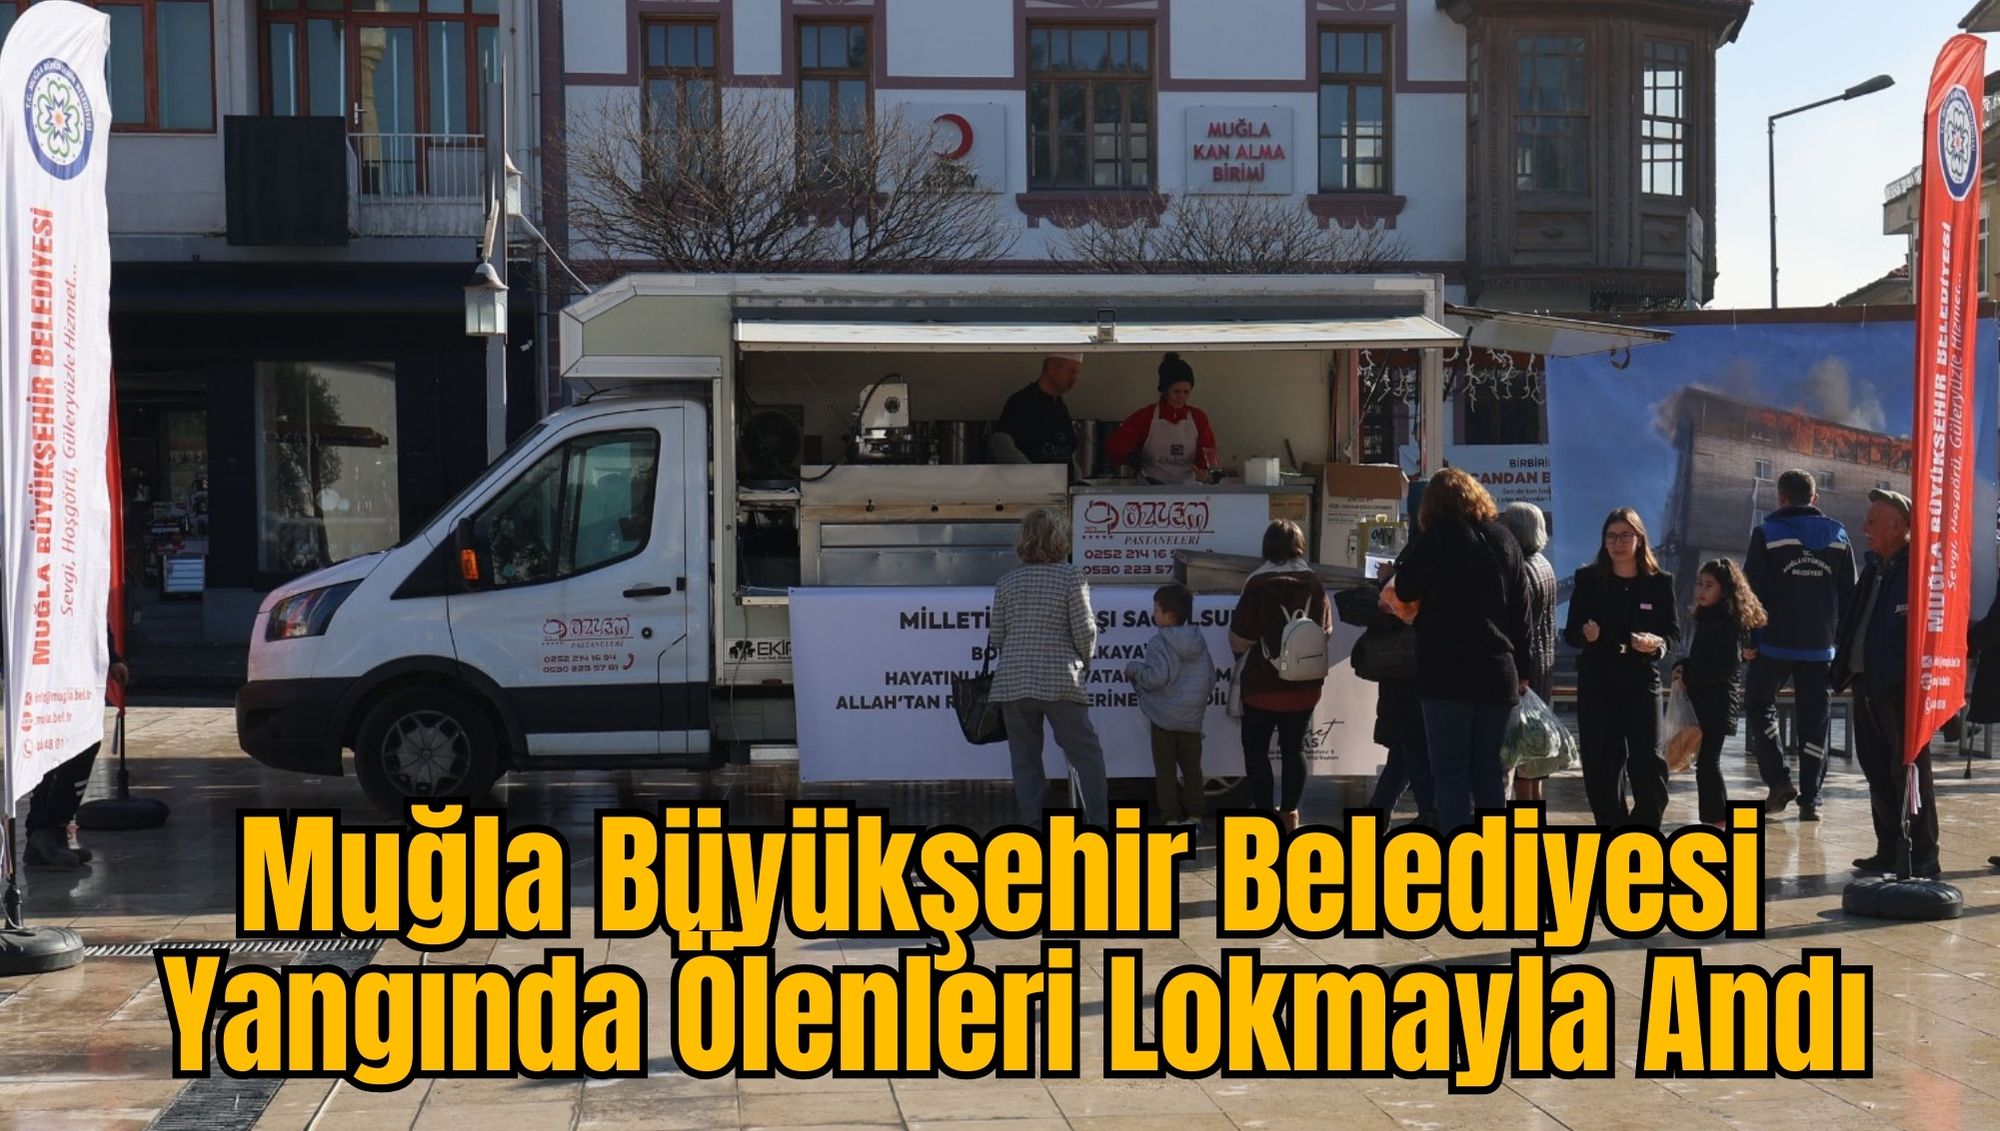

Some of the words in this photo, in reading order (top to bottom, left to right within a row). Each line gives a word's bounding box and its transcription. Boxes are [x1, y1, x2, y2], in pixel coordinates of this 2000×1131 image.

[1207, 118, 1271, 138] MUĞLA
[1193, 143, 1230, 160] KAN
[1235, 143, 1285, 160] ALMA
[1213, 162, 1265, 182] BİRİMİ
[29, 207, 54, 367] BELEDİYESİ
[61, 353, 80, 459] Güleryüzle
[26, 376, 56, 554] BÜYÜKŞEHİR
[1509, 456, 1549, 468] BİRBİRİ
[61, 467, 79, 553] Hoşgörü,
[1084, 549, 1122, 559] 0252
[1125, 549, 1149, 559] 214
[1153, 549, 1166, 559] 16
[1083, 565, 1120, 575] 0530
[1124, 564, 1152, 574] 223
[1155, 564, 1173, 574] 57
[60, 561, 78, 617] Sevgi,
[31, 563, 51, 666] MUĞLA
[900, 606, 991, 629] MİLLETİ
[1096, 610, 1116, 634] ŞI
[971, 646, 1000, 661] BO
[836, 695, 941, 710] ALLAH'TAN
[1087, 688, 1138, 708] ERİNE
